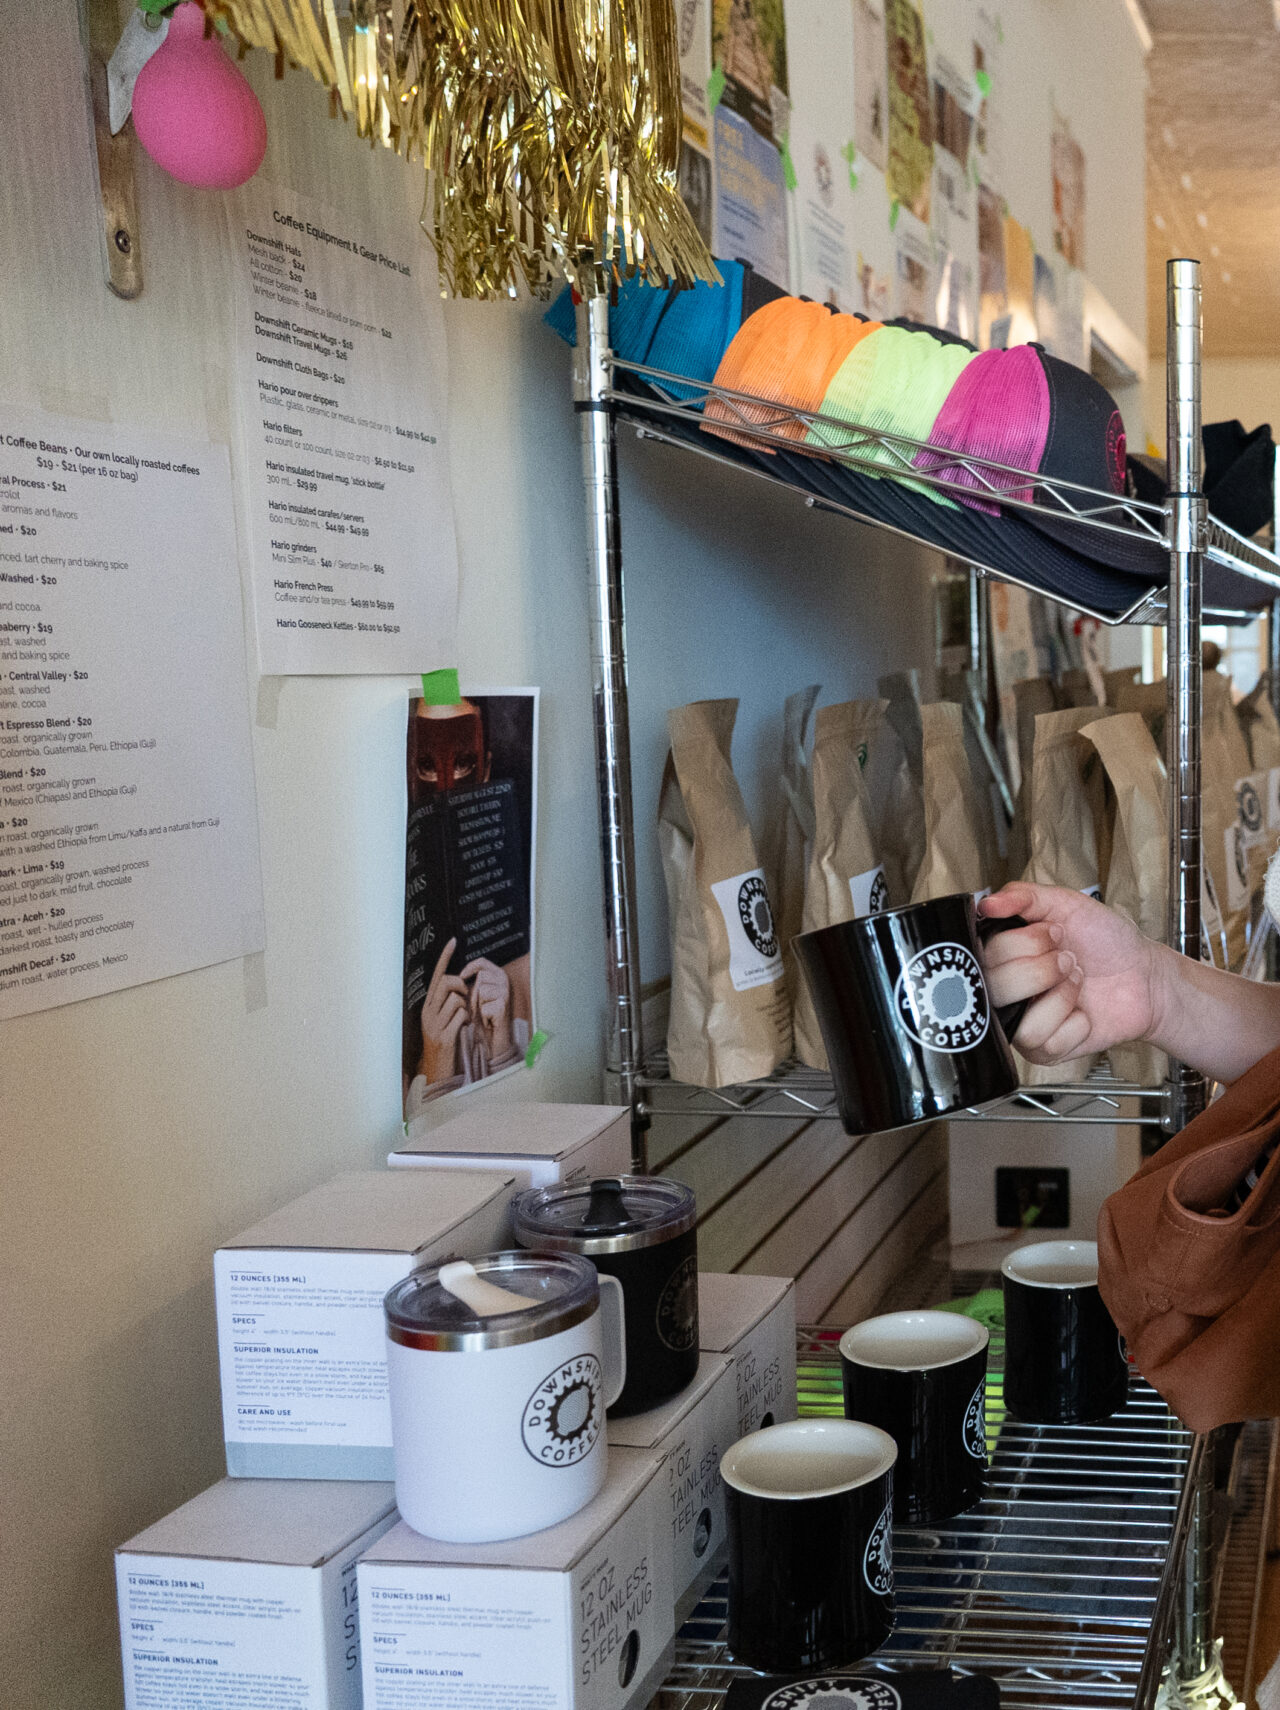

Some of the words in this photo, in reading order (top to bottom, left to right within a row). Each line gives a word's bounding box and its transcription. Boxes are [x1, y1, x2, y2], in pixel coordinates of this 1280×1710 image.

[246, 229, 284, 251] Downshift
[273, 211, 305, 232] Coffee
[306, 223, 352, 252] Equipment
[359, 246, 378, 262] Gear
[254, 311, 290, 331] Downshift
[291, 323, 319, 339] Ceramic
[320, 332, 337, 346] Mugs
[255, 325, 291, 344] Downshift
[292, 336, 313, 351] Travel
[313, 343, 331, 357] Mugs
[256, 352, 293, 370] Downshift
[294, 362, 312, 376] Cloth
[313, 367, 329, 381] Bags
[258, 379, 279, 392] Hario
[280, 386, 296, 397] pour
[297, 390, 312, 400] over
[263, 420, 282, 432] Hario
[283, 424, 303, 436] filters
[6, 436, 38, 450] Coffee
[39, 441, 68, 454] Beans
[75, 447, 91, 458] Our
[92, 451, 110, 461] own
[112, 453, 140, 468] locally
[141, 458, 171, 471] roasted
[172, 464, 201, 475] coffees
[36, 457, 54, 470] $19
[61, 460, 78, 472] $21
[79, 461, 96, 475] (per
[98, 466, 107, 477] 16
[109, 470, 119, 478] oz
[120, 469, 139, 483] bag)
[266, 460, 284, 472] Hario
[285, 463, 315, 478] insulated
[12, 476, 45, 489] Process
[52, 481, 67, 492] $21
[35, 507, 50, 517] and
[269, 500, 287, 511] Hario
[288, 502, 316, 515] insulated
[20, 525, 37, 536] $20
[271, 540, 290, 550] Hario
[68, 556, 82, 567] and
[41, 575, 57, 585] $20
[274, 579, 293, 590] Hario
[294, 580, 316, 591] French
[317, 582, 333, 593] Press
[37, 622, 53, 634] $19
[276, 619, 296, 628] Hario
[297, 619, 332, 630] Gooseneck
[9, 671, 40, 681] Central
[42, 671, 67, 682] Valley
[73, 670, 89, 680] $20
[6, 720, 45, 731] Espresso
[46, 718, 71, 728] Blend
[77, 717, 92, 726] $20
[30, 768, 47, 778] $20
[12, 817, 28, 827] $20
[23, 864, 43, 874] Lima
[50, 860, 65, 870] $19
[23, 911, 44, 923] Aceh
[50, 908, 65, 918] $20
[30, 956, 54, 970] Decaf
[60, 953, 76, 963] $20
[902, 947, 984, 1010] DOWNSHIFT
[921, 1012, 986, 1046] COFFEE
[273, 1275, 290, 1283] [355
[292, 1275, 307, 1284] ML]
[232, 1317, 257, 1325] SPECS
[234, 1345, 272, 1353] SUPERIOR
[273, 1347, 319, 1355] INSULATION
[744, 1358, 756, 1383] OZ
[737, 1357, 780, 1412] TAINLESS
[259, 1408, 275, 1416] AND
[738, 1404, 761, 1437] TEEL
[763, 1377, 782, 1411] MUG
[677, 1448, 691, 1477] OZ
[670, 1444, 718, 1512] TAINLESS
[671, 1500, 698, 1539] TEEL
[700, 1466, 720, 1507] MUG
[138, 1578, 169, 1587] OUNCES
[371, 1591, 379, 1599] 12
[382, 1592, 414, 1600] OUNCES
[581, 1592, 594, 1623] 12
[599, 1566, 615, 1601] OZ
[581, 1557, 648, 1654] STAINLESS
[131, 1622, 154, 1631] SPECS
[582, 1624, 622, 1685] STEEL
[626, 1582, 651, 1630] MUG
[373, 1636, 398, 1644] SPECS
[133, 1653, 170, 1662] SUPERIOR
[172, 1656, 218, 1666] INSULATION
[375, 1666, 413, 1675] SUPERIOR
[416, 1668, 463, 1677] INSULATION
